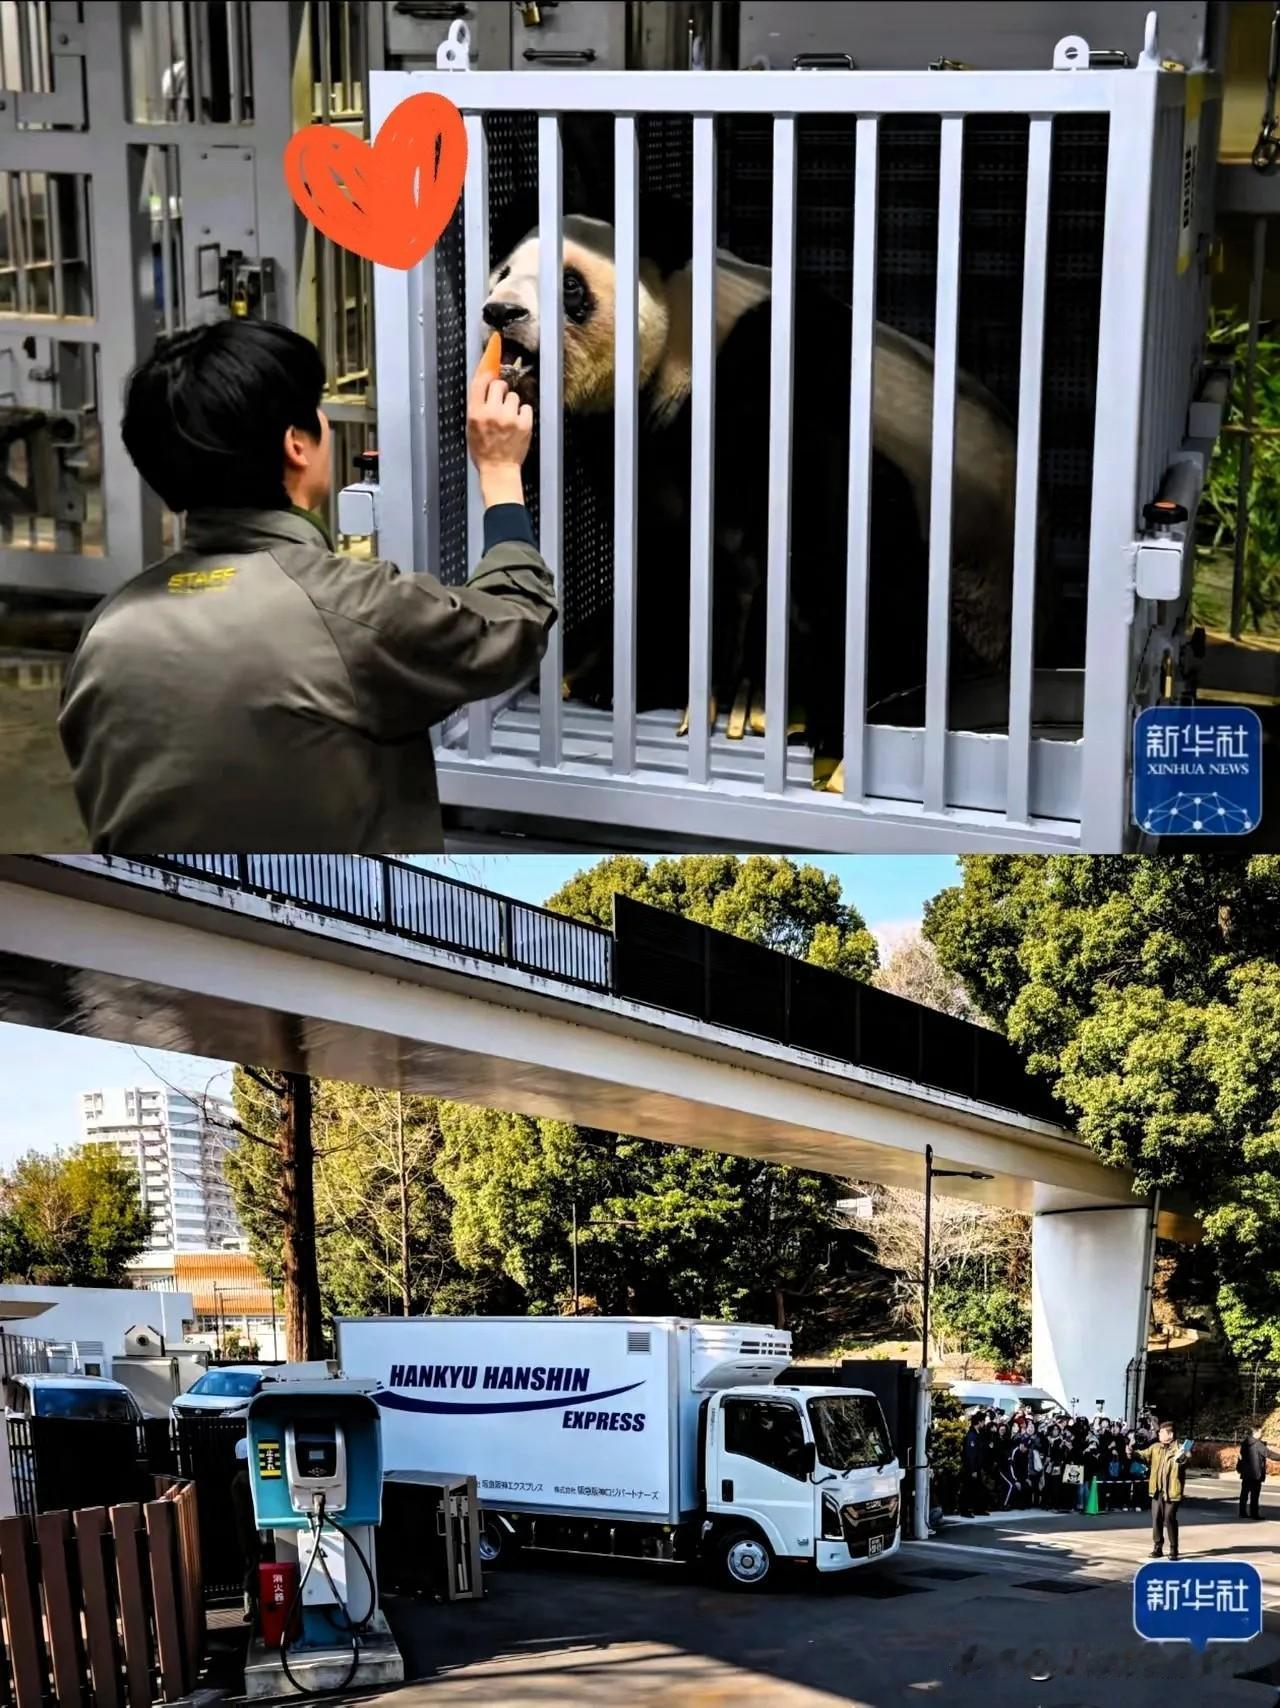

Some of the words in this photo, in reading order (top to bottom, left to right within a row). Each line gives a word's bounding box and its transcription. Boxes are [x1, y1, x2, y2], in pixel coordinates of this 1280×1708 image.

[389, 1364, 478, 1389] HANKYU
[482, 1366, 590, 1392] HANSHIN
[562, 1410, 646, 1432] EXPRESS
